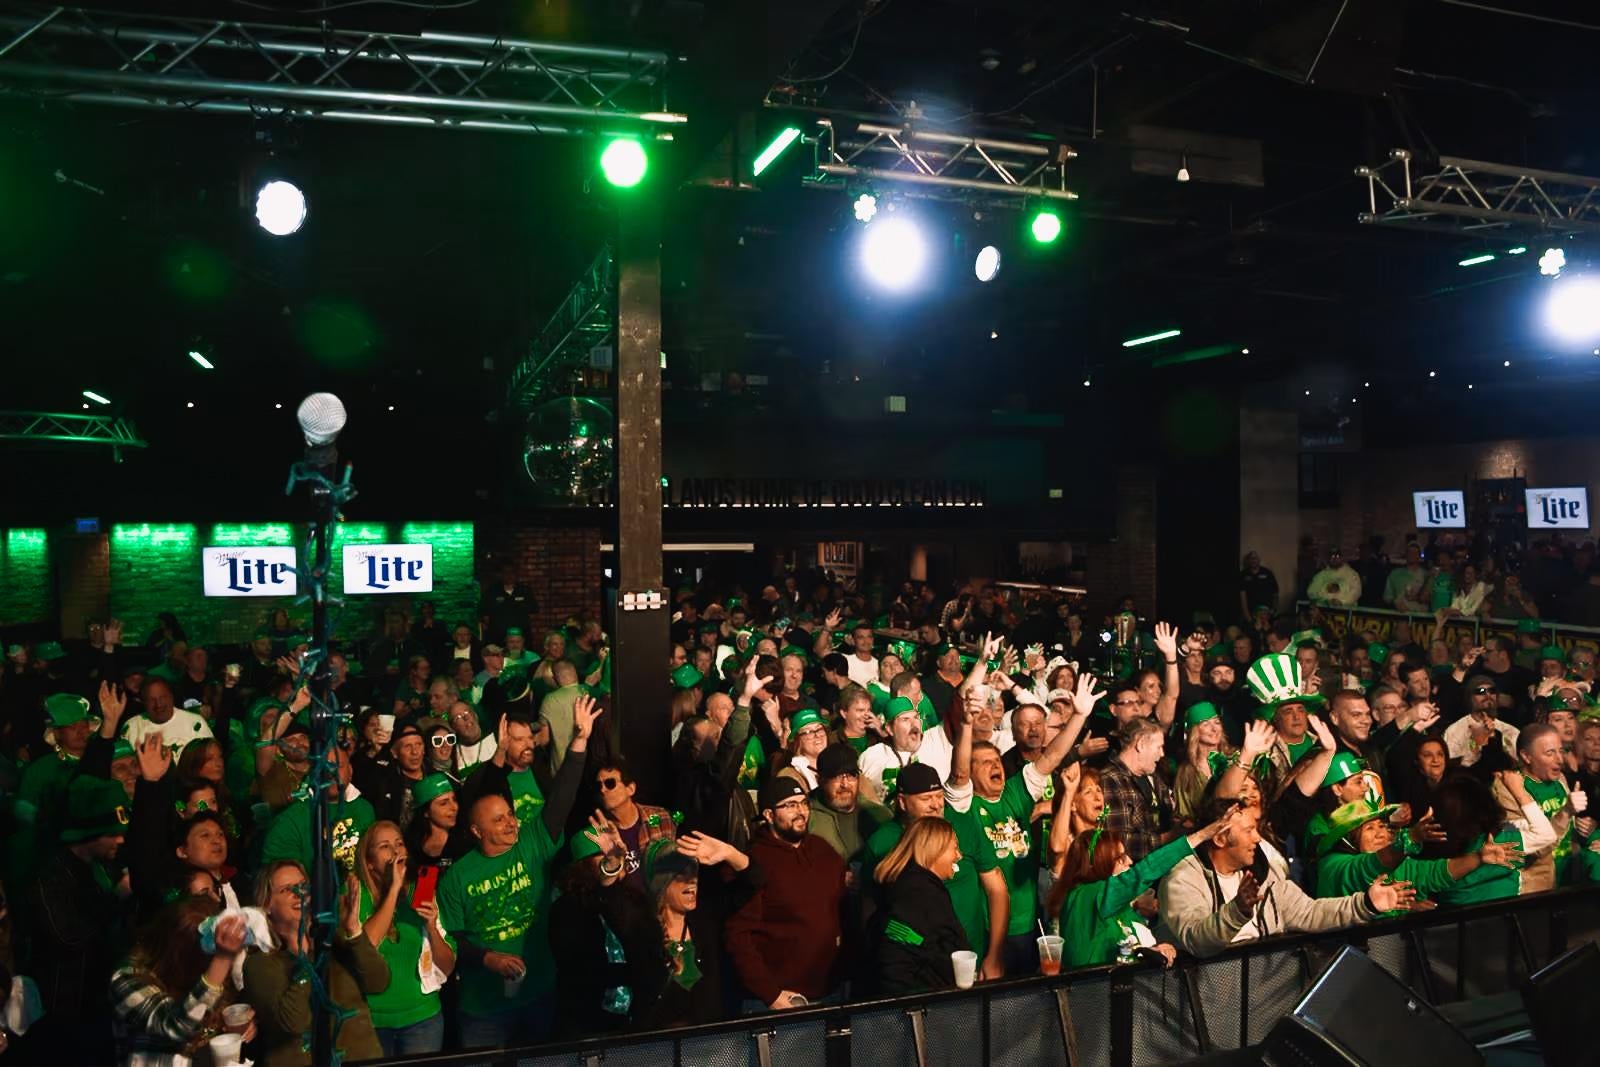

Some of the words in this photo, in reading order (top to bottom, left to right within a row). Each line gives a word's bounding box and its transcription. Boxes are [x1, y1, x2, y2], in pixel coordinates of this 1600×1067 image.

[1425, 499, 1459, 525] Lite
[1541, 497, 1580, 525] Lite
[227, 557, 287, 593] Lite
[366, 555, 423, 590] Lite
